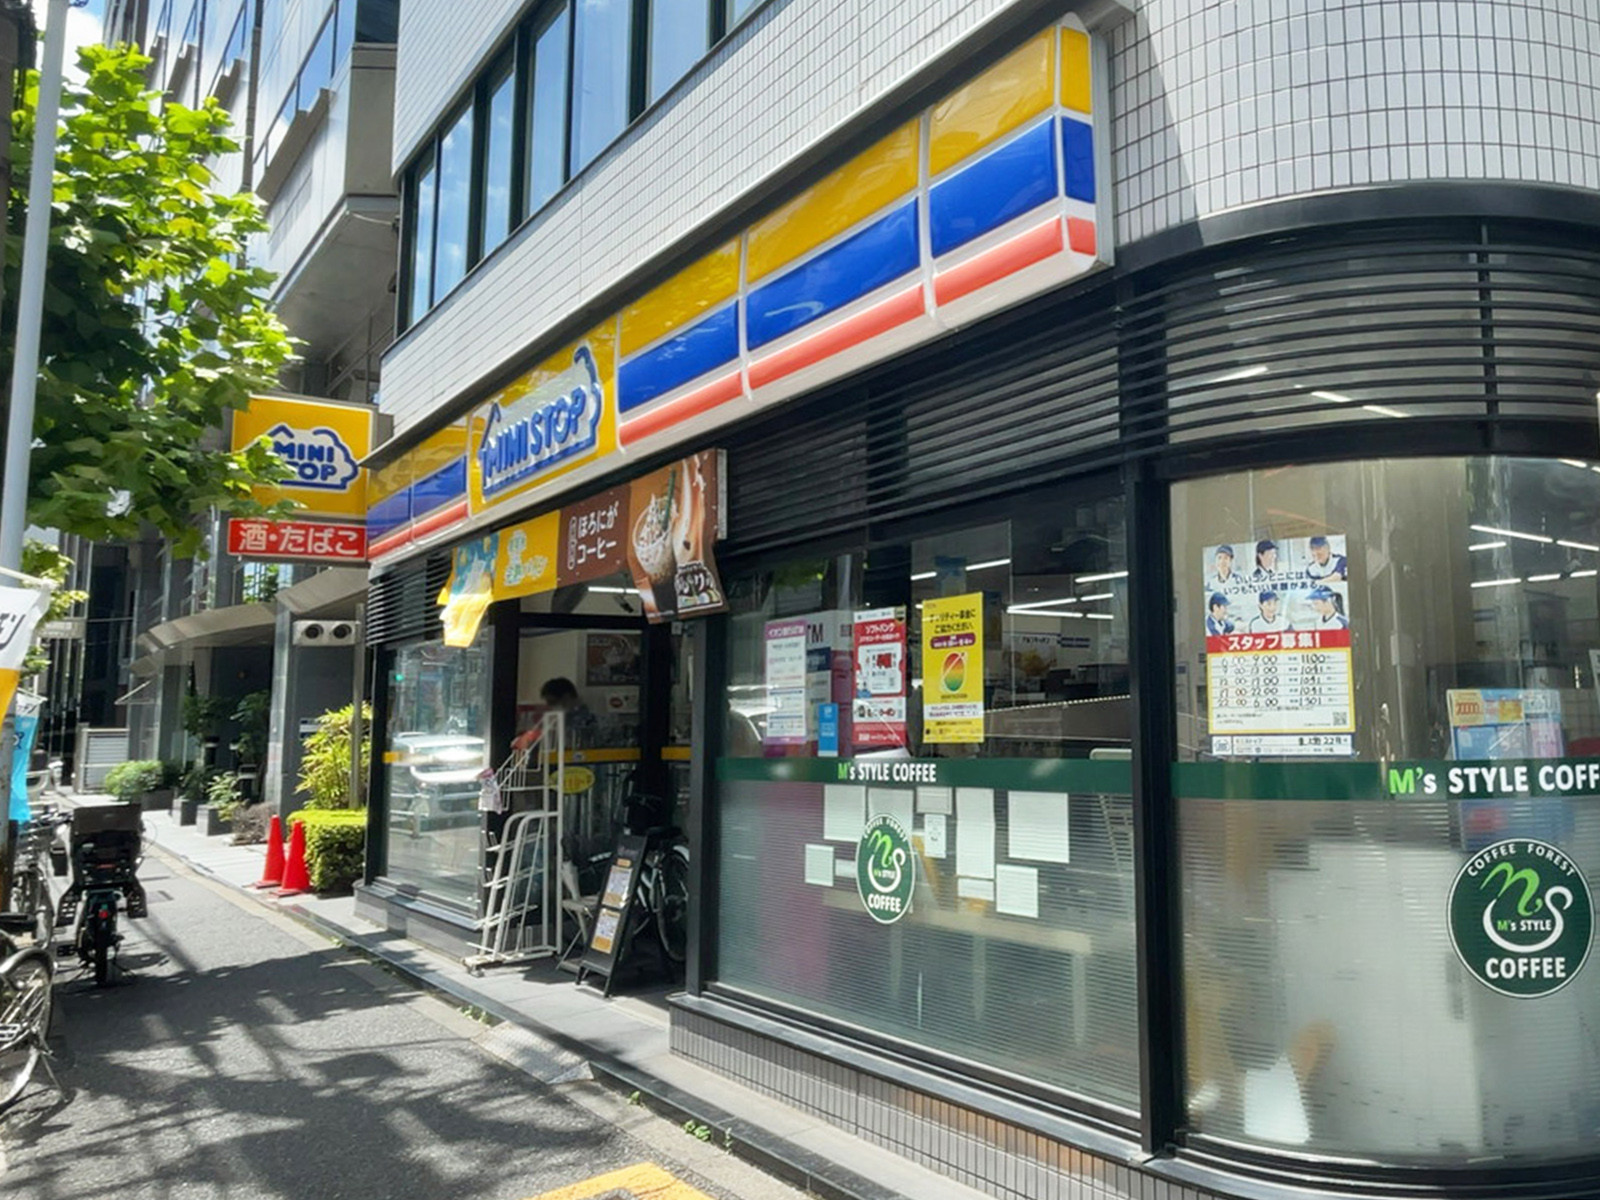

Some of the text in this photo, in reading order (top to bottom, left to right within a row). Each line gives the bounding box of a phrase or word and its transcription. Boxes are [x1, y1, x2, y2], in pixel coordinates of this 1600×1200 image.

[273, 441, 334, 463] MINI
[238, 523, 359, 555] 酒・たばこ
[577, 537, 617, 564] コーヒー
[858, 763, 890, 781] STYLE
[893, 764, 937, 782] COFFEE
[1389, 766, 1437, 794] M's
[1448, 766, 1529, 794] STYLE
[1467, 843, 1576, 877] COFFEE FOREST
[868, 893, 902, 913] COFFEE
[1497, 919, 1552, 931] M's STYLE
[1485, 957, 1567, 979] COFFEE
